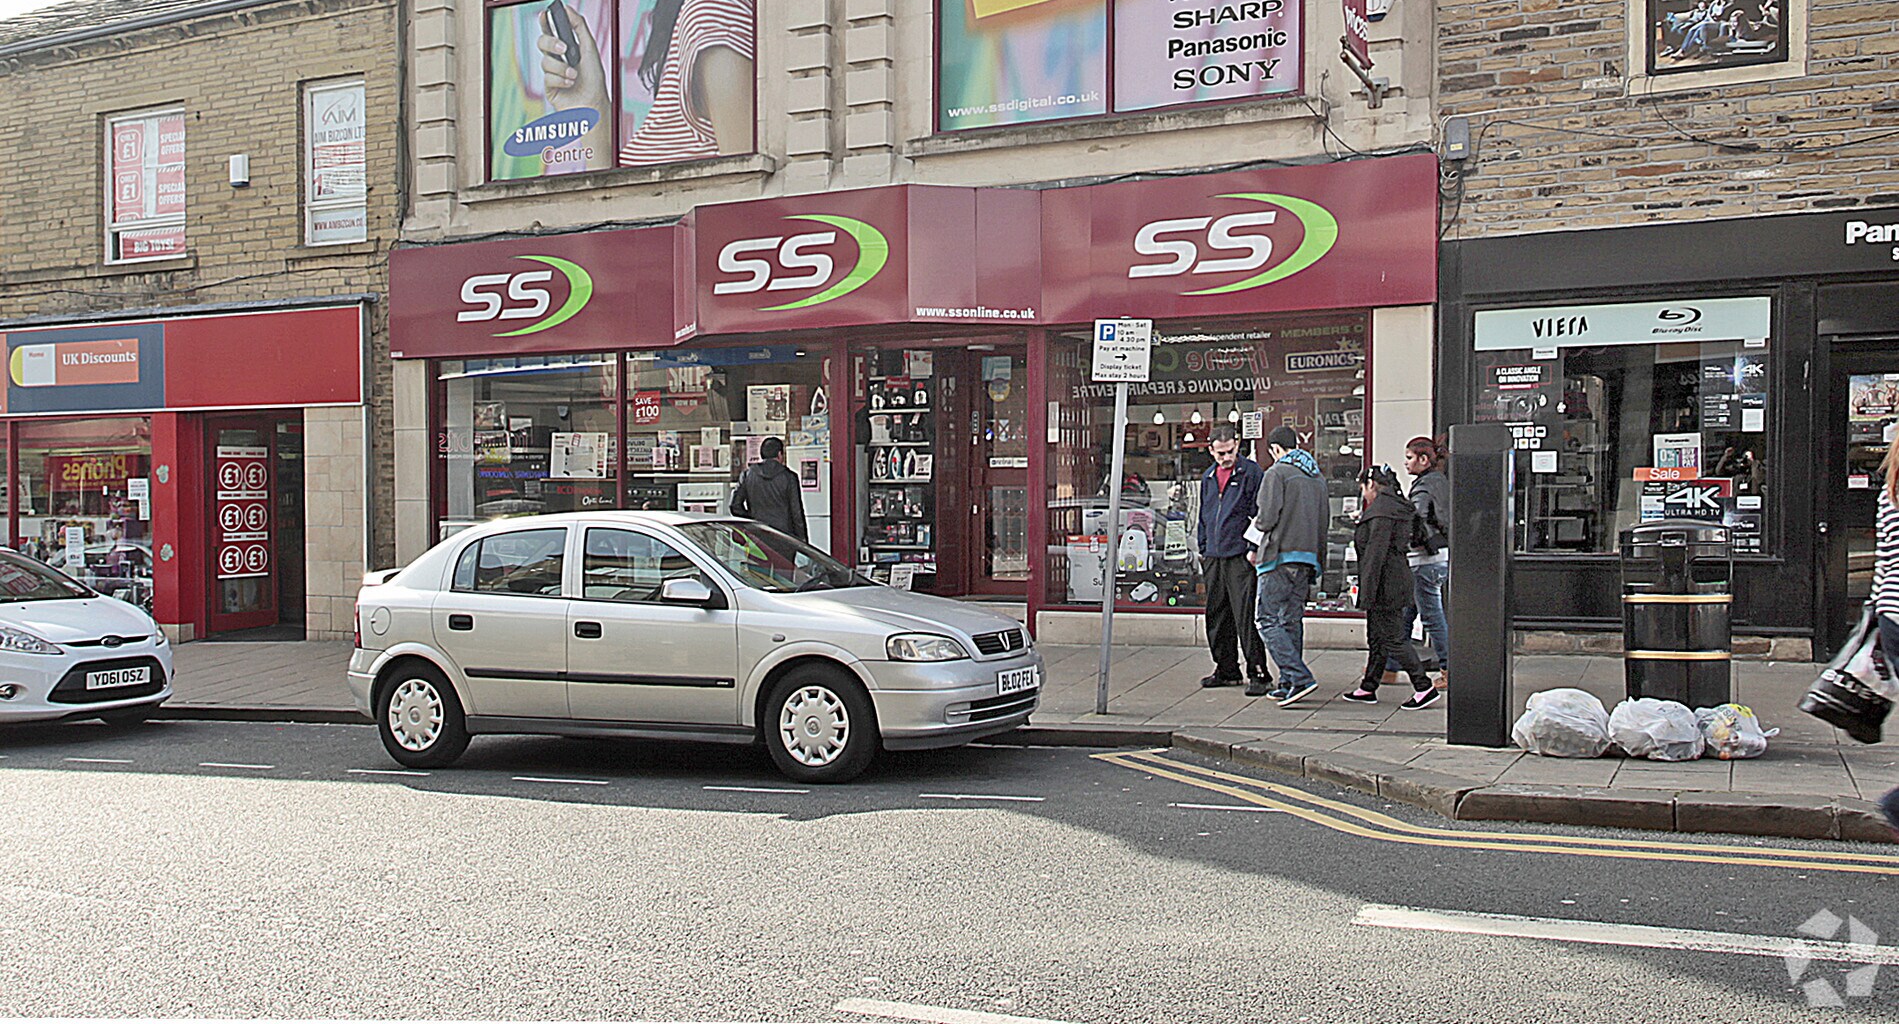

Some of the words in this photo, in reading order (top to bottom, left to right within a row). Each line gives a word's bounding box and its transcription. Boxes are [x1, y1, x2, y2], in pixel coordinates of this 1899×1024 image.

[1173, 0, 1283, 28] SHARP
[1168, 27, 1287, 58] Panasonic
[1173, 58, 1280, 90] SONY
[948, 91, 1099, 118] www.ssdigital.co.uk
[515, 120, 589, 144] SAMSUNG
[123, 142, 136, 159] £1
[542, 146, 594, 165] Centre
[122, 183, 136, 200] £1
[1846, 221, 1899, 244] Pan
[134, 241, 149, 253] BIG
[150, 239, 174, 252] TOYS!
[1128, 211, 1277, 278] SS
[714, 232, 836, 295] SS
[456, 271, 553, 322] SS
[916, 306, 1035, 319] www.ssonline.co.uk
[1103, 326, 1114, 340] P
[1246, 331, 1272, 339] retailer
[1281, 325, 1350, 338] MEMBERS
[1532, 316, 1588, 338] VIERA
[62, 353, 79, 366] UK
[81, 351, 137, 366] Discounts
[1290, 353, 1355, 369] EURONICS
[635, 397, 652, 406] SAVE
[636, 405, 659, 418] £100
[224, 468, 239, 484] £1
[248, 468, 263, 484] £1
[1649, 468, 1680, 480] Sale
[1665, 486, 1721, 508] 4K
[224, 509, 239, 526] £1
[249, 509, 263, 525] £1
[224, 552, 240, 568] £1
[249, 550, 263, 567] £1
[93, 671, 120, 686] YD61
[122, 669, 144, 683] OSZ
[1002, 672, 1021, 692] BL02
